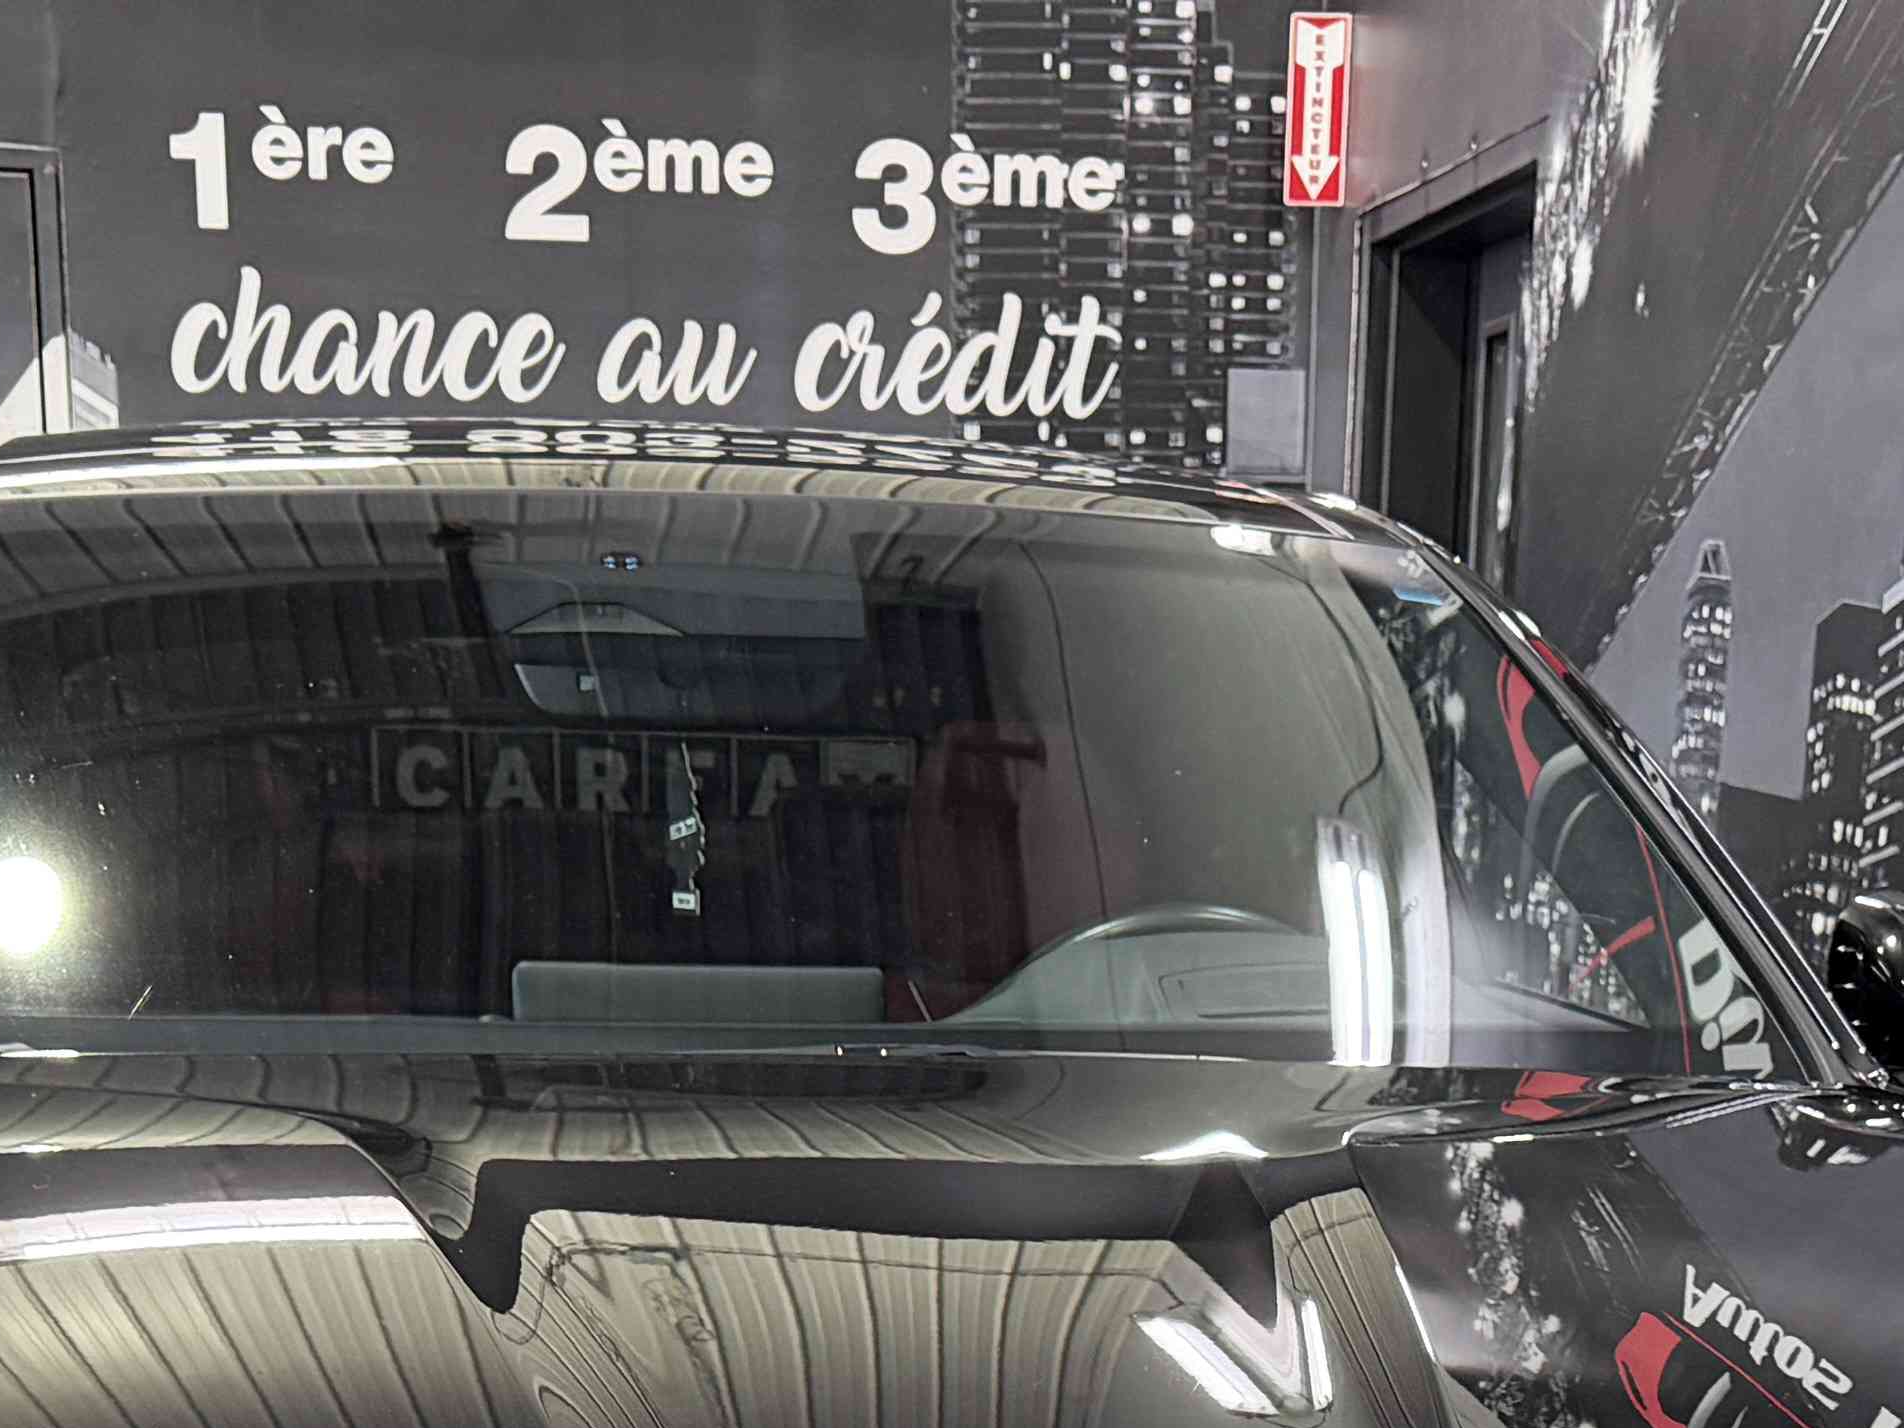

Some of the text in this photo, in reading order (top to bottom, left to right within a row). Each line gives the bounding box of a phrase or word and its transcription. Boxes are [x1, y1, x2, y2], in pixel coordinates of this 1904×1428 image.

[169, 104, 1120, 255] 1ère 2ème 3ème
[1309, 33, 1327, 185] EXTINCTEUR
[170, 264, 1122, 420] chance au crédit
